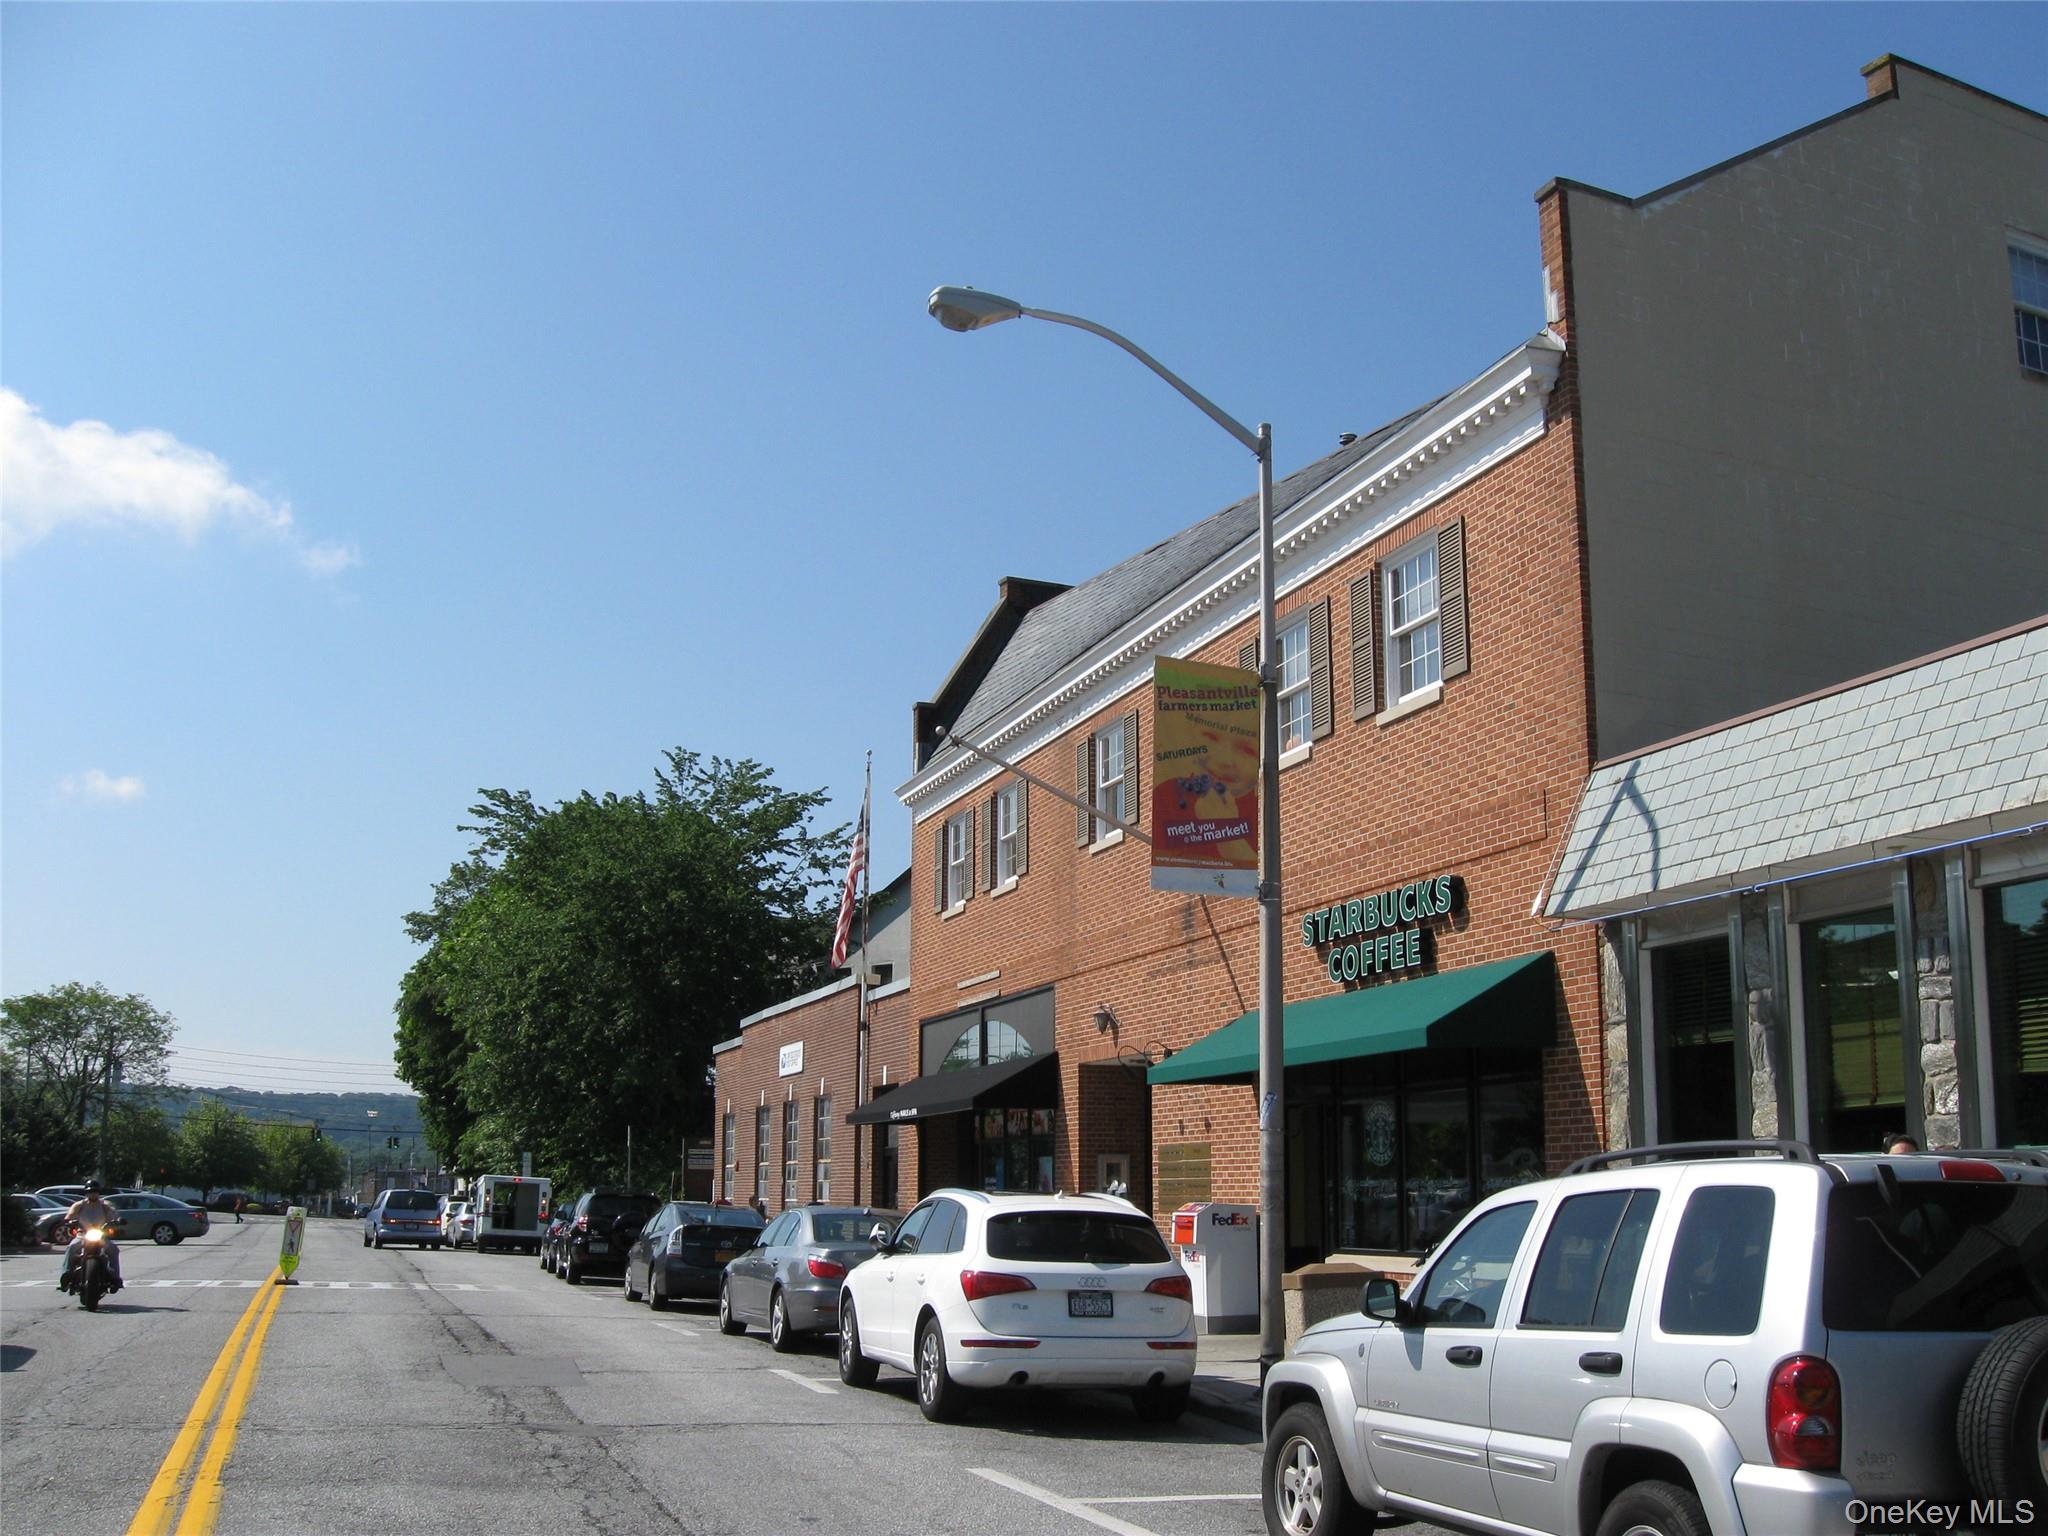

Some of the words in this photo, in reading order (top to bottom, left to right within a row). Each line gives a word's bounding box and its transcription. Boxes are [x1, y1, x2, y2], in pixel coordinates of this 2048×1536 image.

[1157, 686, 1258, 699] Pleasantville
[1159, 701, 1208, 711] farmers
[1210, 699, 1257, 711] market
[1185, 712, 1228, 731] Memorial
[1156, 745, 1208, 761] SATURDAYS
[1167, 821, 1197, 836] meet
[1198, 822, 1216, 834] you
[1190, 834, 1203, 842] the
[1203, 822, 1250, 841] market!
[1302, 874, 1452, 948] STARBUCKS
[1327, 928, 1421, 984] COFFEE
[1212, 1212, 1249, 1226] FedEx
[1184, 1250, 1200, 1262] FedEx
